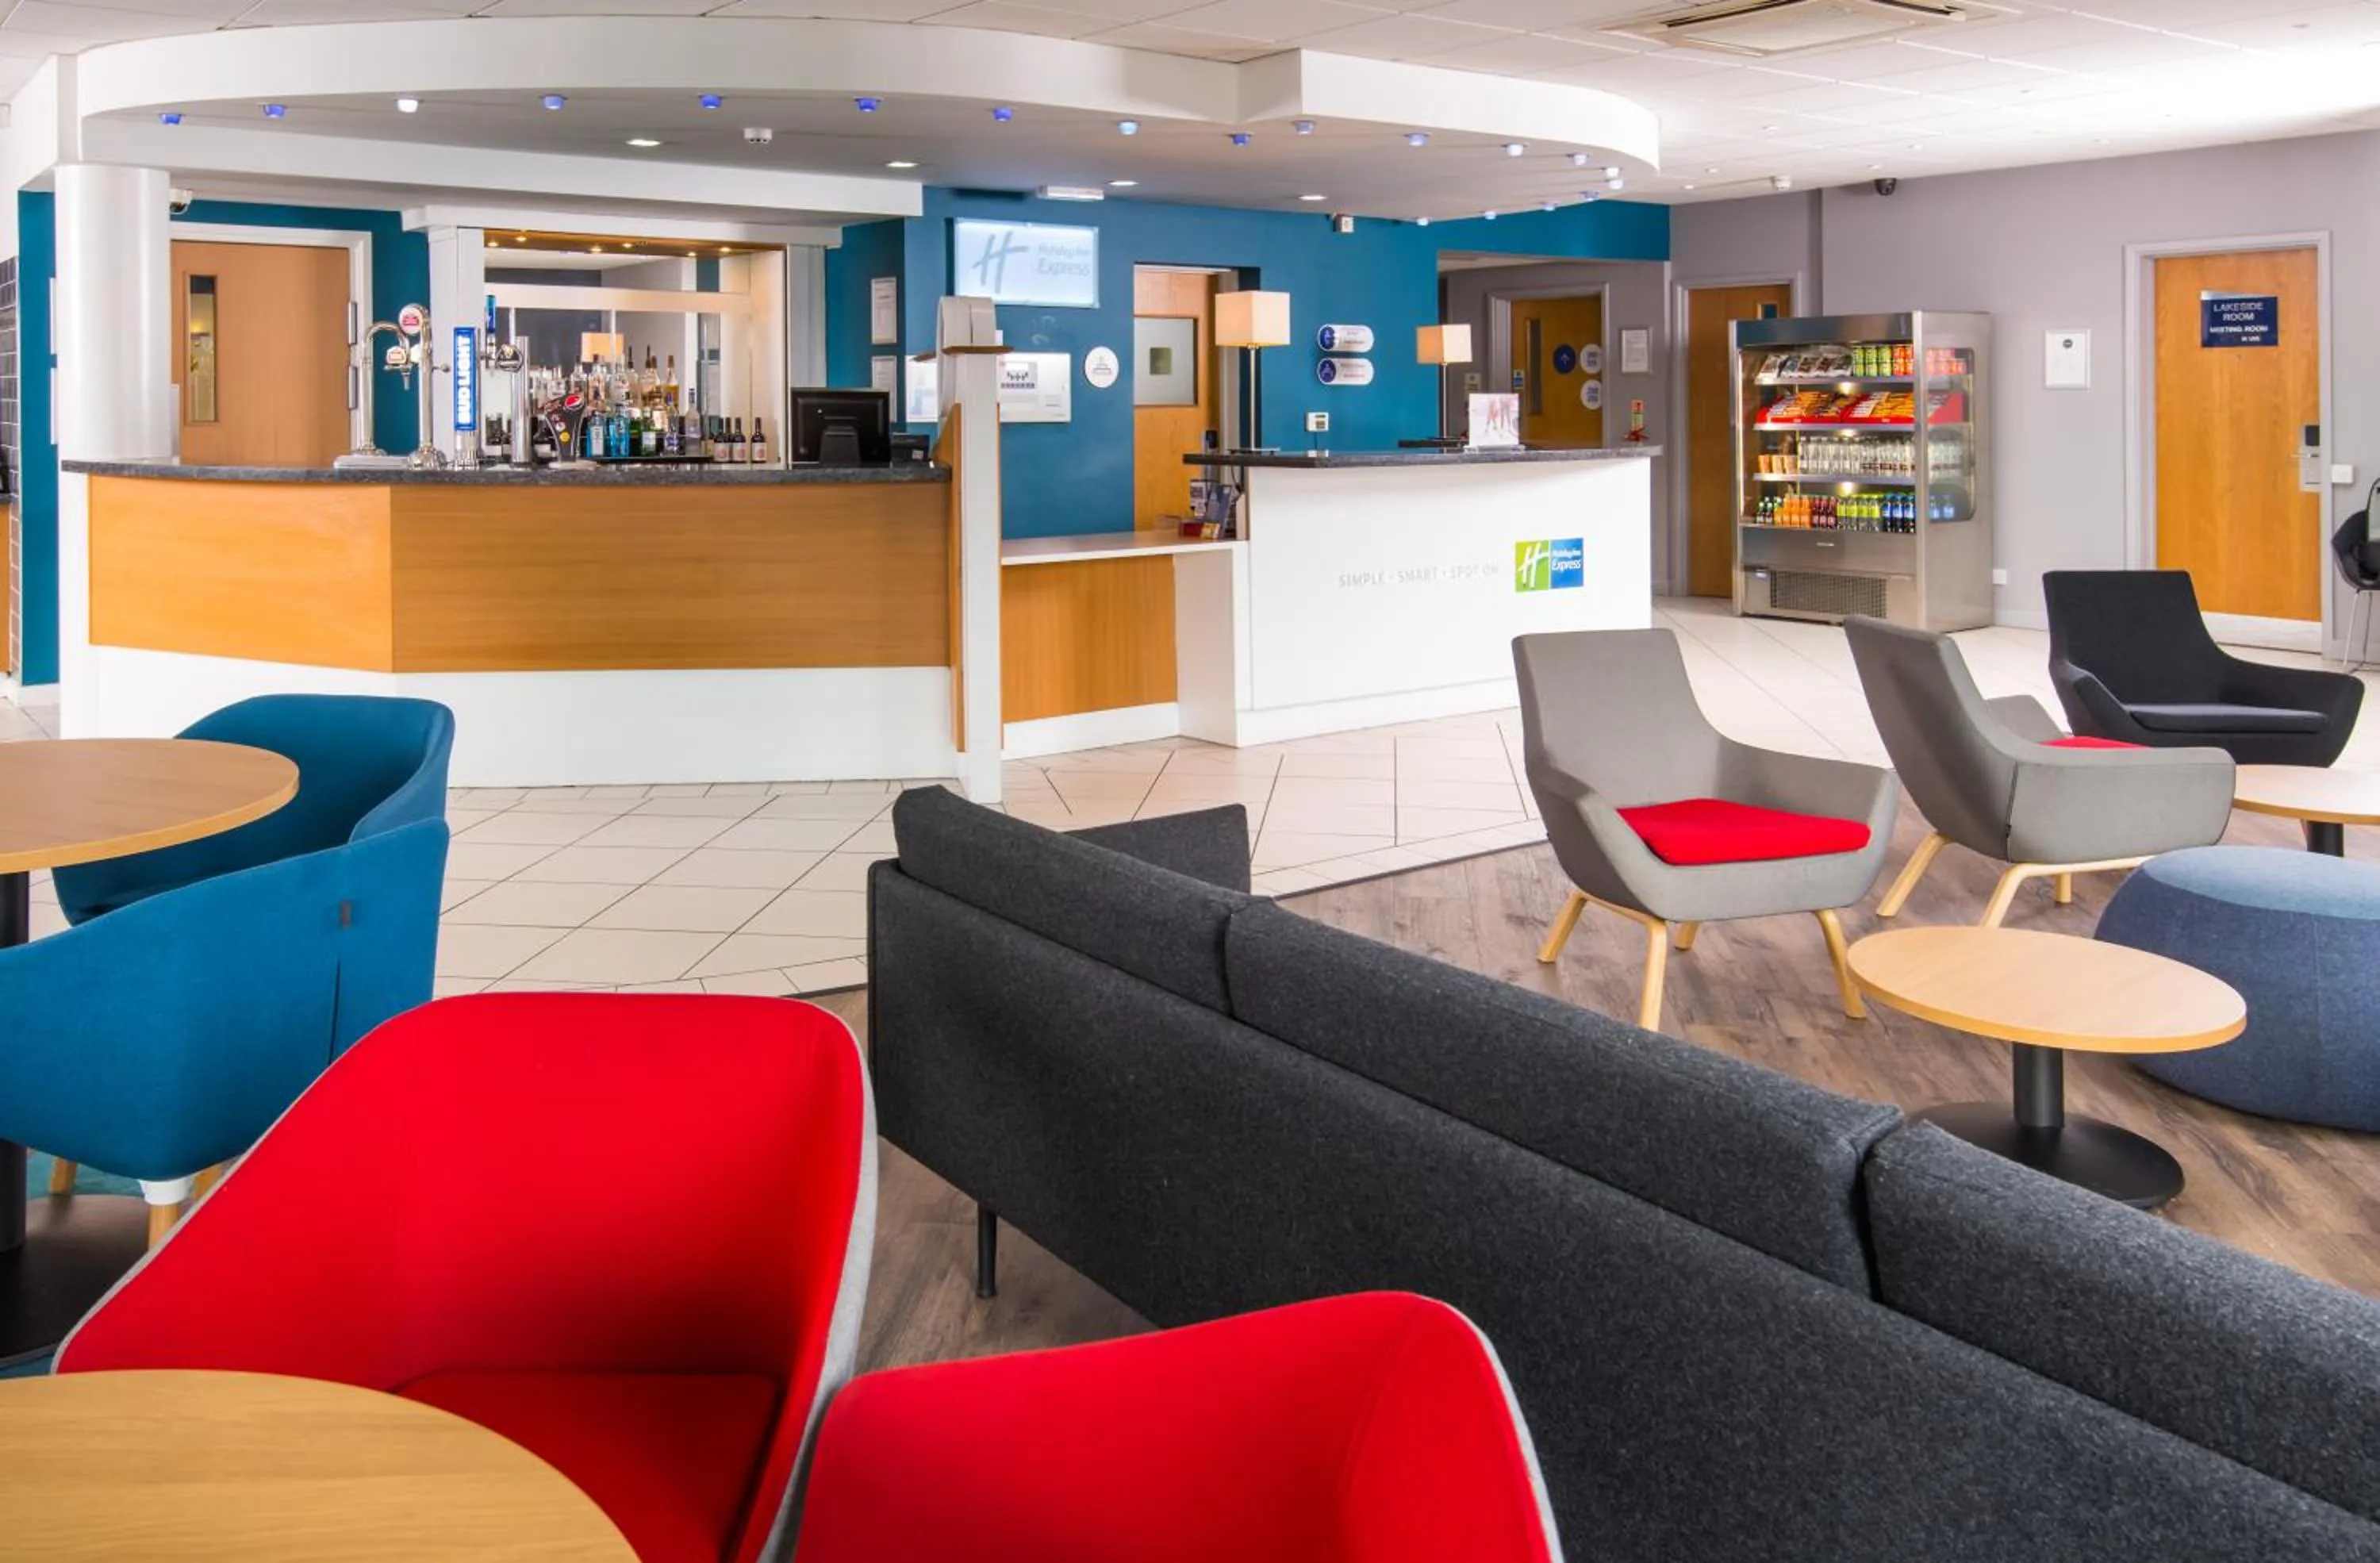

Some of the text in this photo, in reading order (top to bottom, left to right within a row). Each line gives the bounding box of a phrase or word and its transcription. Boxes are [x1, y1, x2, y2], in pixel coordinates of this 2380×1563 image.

[1037, 258, 1091, 277] Express
[2213, 302, 2263, 312] LAKESIDE
[2222, 313, 2255, 321] ROOM
[458, 334, 470, 424] BUD LIGHT
[1552, 558, 1582, 573] Express
[1338, 562, 1499, 589] SIMPLE SMART SPOT ON
